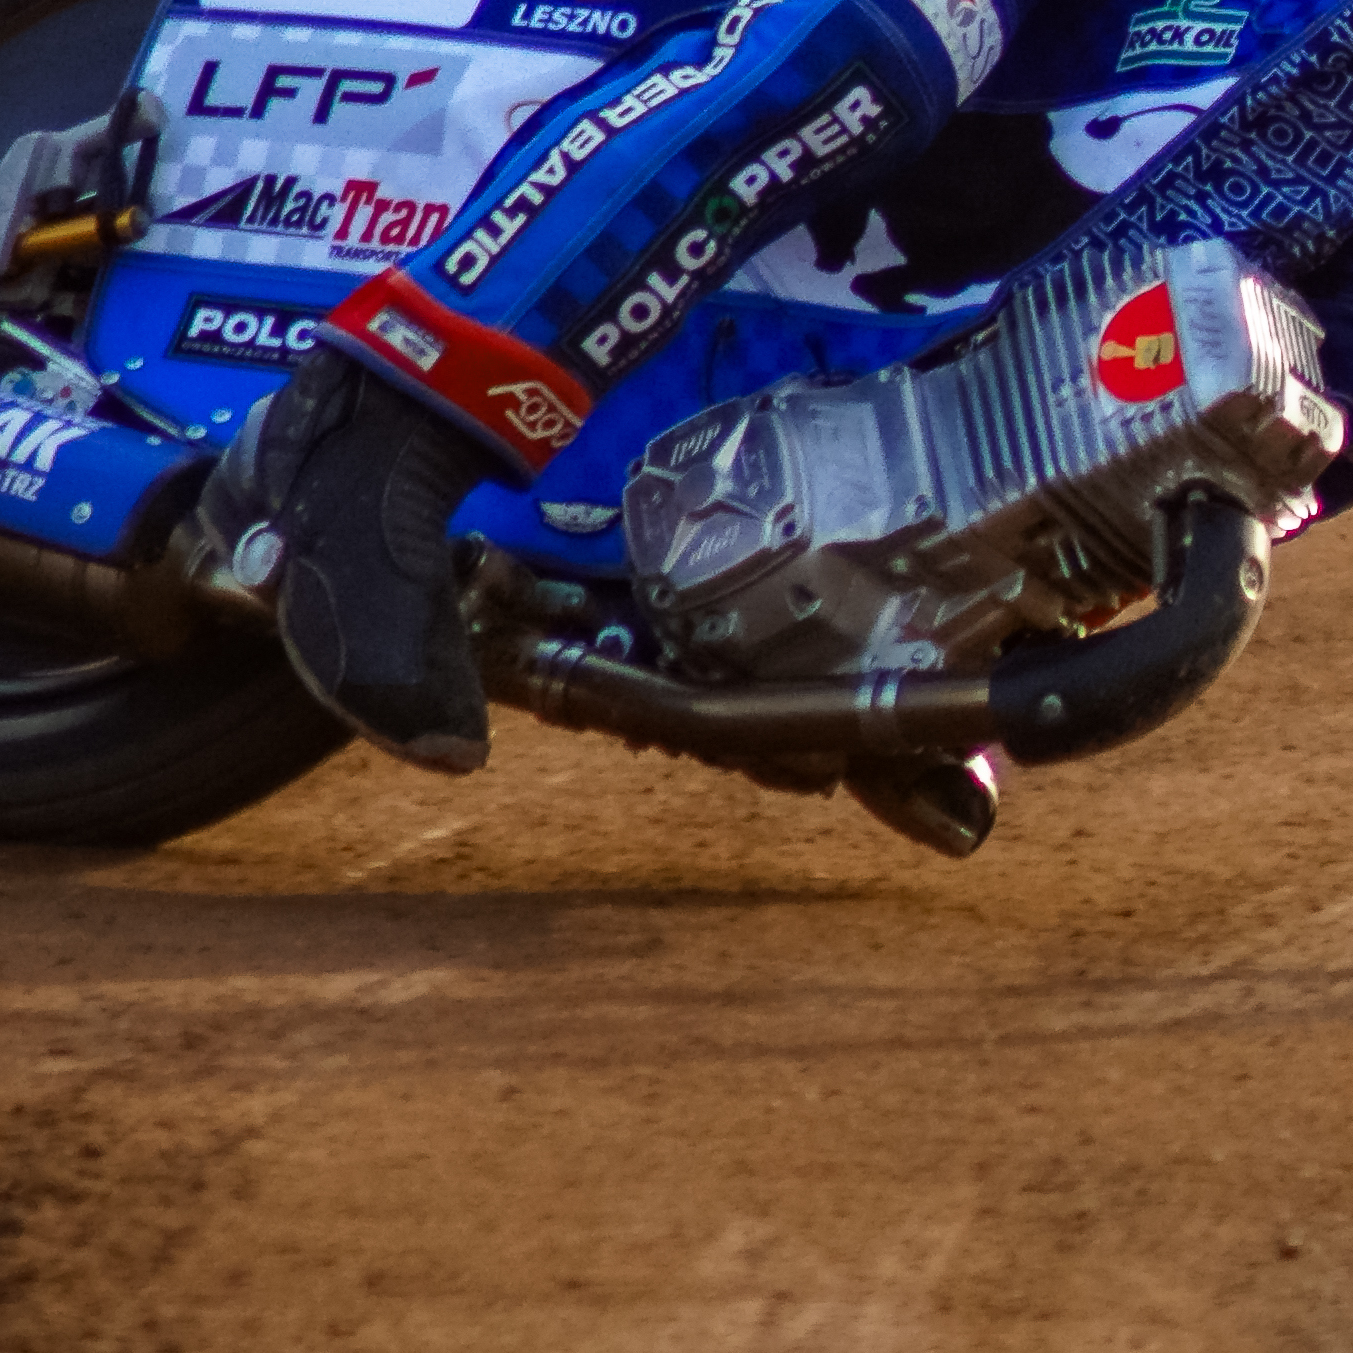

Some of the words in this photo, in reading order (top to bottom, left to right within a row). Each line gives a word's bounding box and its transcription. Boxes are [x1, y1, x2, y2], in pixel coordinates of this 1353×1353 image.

[511, 2, 637, 40] LESZNO
[1193, 25, 1240, 47] OIL
[186, 60, 398, 125] LFP
[445, 118, 606, 287] BALTIC
[581, 85, 885, 367] POLCOPPER
